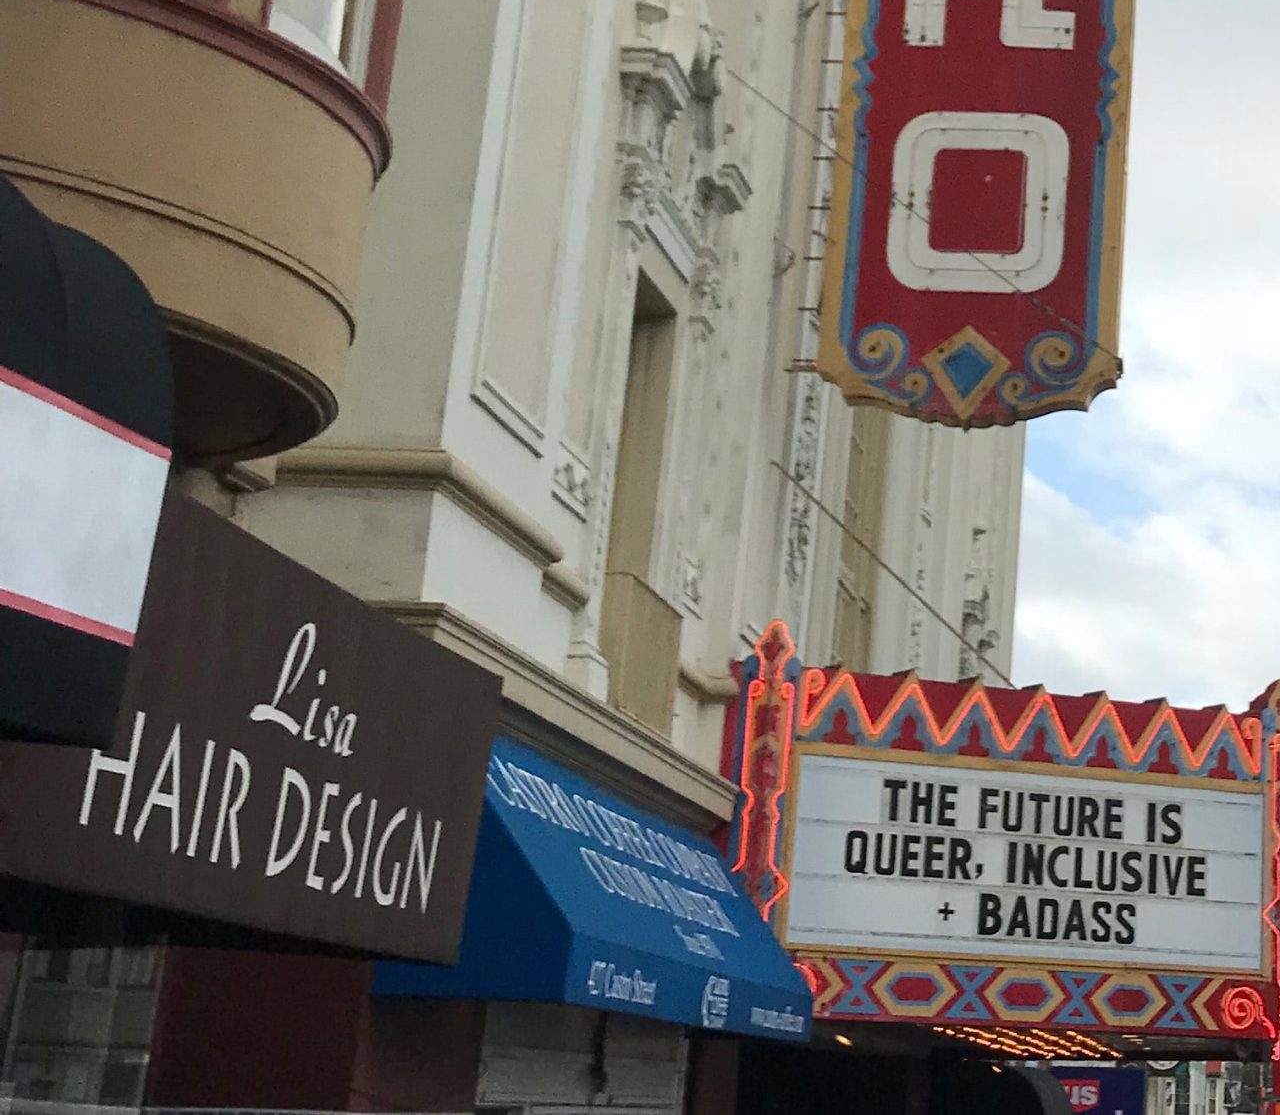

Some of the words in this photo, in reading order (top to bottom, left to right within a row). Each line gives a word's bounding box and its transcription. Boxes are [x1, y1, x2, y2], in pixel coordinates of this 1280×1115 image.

[249, 622, 358, 757] Lisa
[79, 710, 250, 870] HAIR
[265, 766, 443, 914] DESIGN
[883, 779, 958, 828] THE
[978, 787, 1124, 840] FUTURE
[1146, 802, 1183, 845] IS
[844, 830, 983, 880] QUEER,
[1006, 842, 1208, 897] INCLUSIVE
[977, 892, 1136, 945] BADASS
